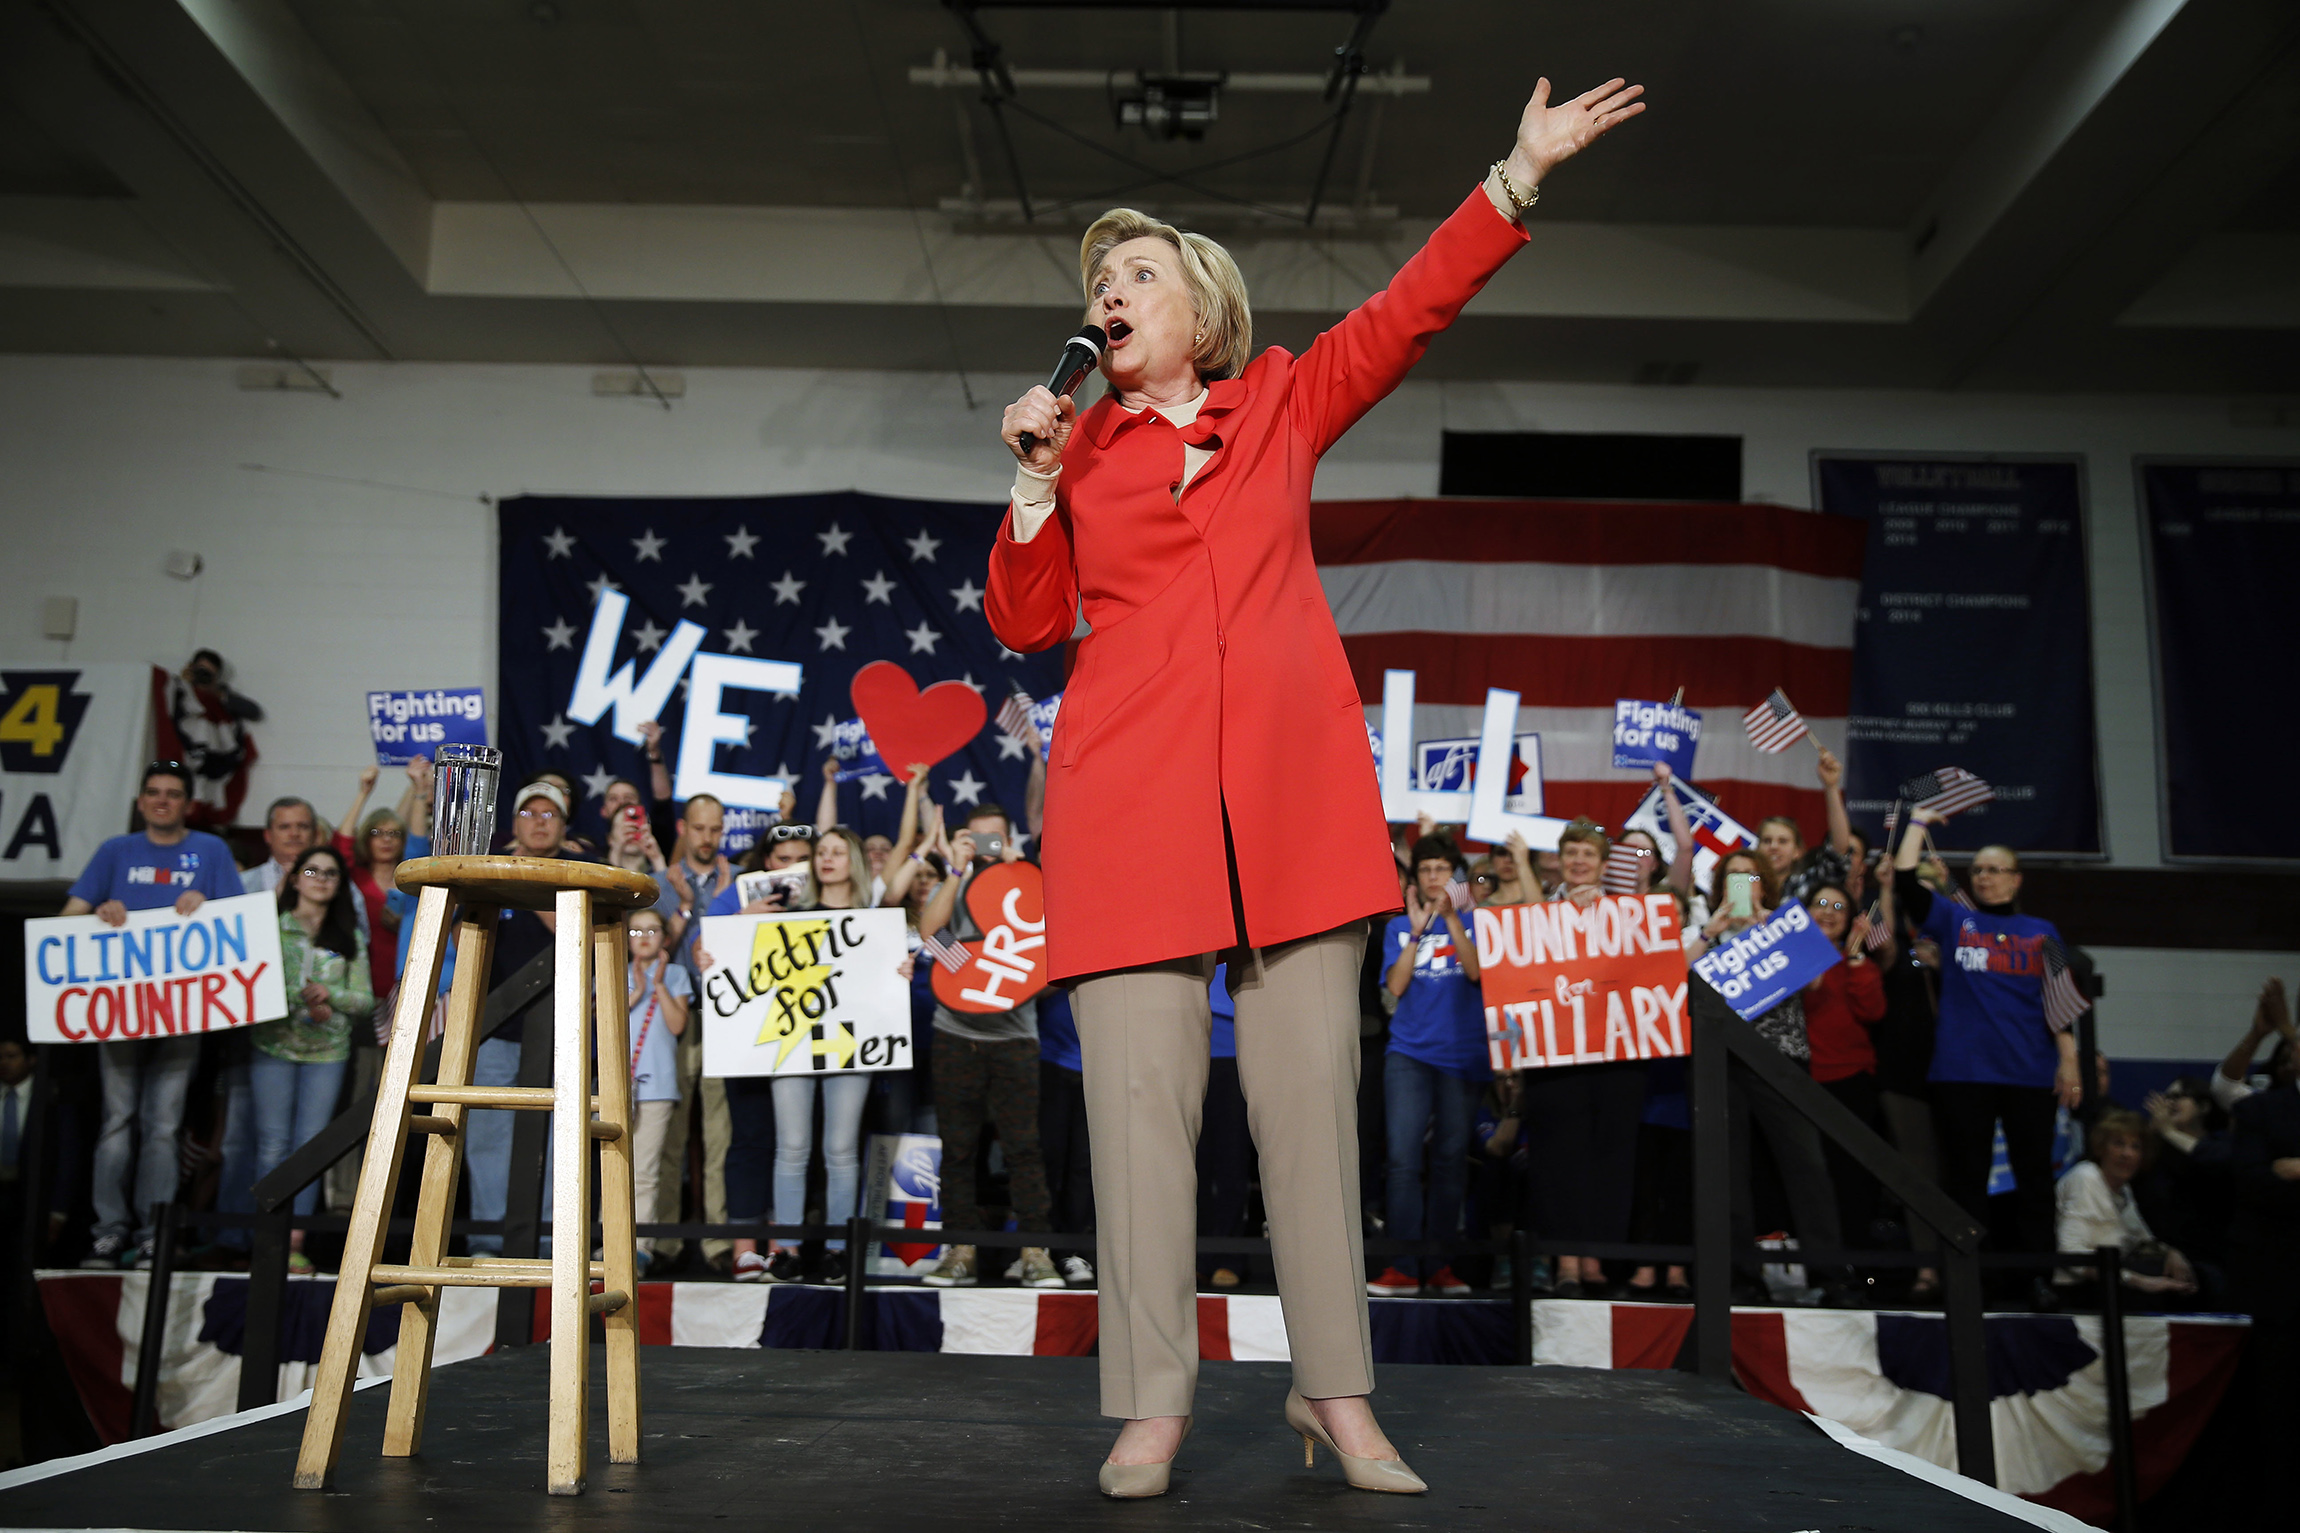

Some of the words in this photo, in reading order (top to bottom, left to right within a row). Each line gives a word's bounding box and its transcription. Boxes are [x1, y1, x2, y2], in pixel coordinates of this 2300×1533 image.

[369, 690, 483, 723] Fighting
[370, 717, 408, 743] for
[410, 722, 446, 743] us
[566, 586, 803, 811] WE
[1616, 700, 1701, 742] Fighting
[1613, 722, 1654, 747] for
[1654, 731, 1680, 752] us
[0, 790, 61, 860] A
[37, 912, 247, 985] CLINTON
[706, 916, 865, 1017] Electric
[960, 887, 1046, 1010] HRC
[1473, 894, 1681, 969] DUNMORE
[1693, 904, 1810, 983] Fighting
[1751, 950, 1790, 981] us
[55, 961, 268, 1042] COUNTRY
[776, 971, 843, 1036] for
[1484, 982, 1689, 1071] HILLARY
[812, 1019, 909, 1070] Her
